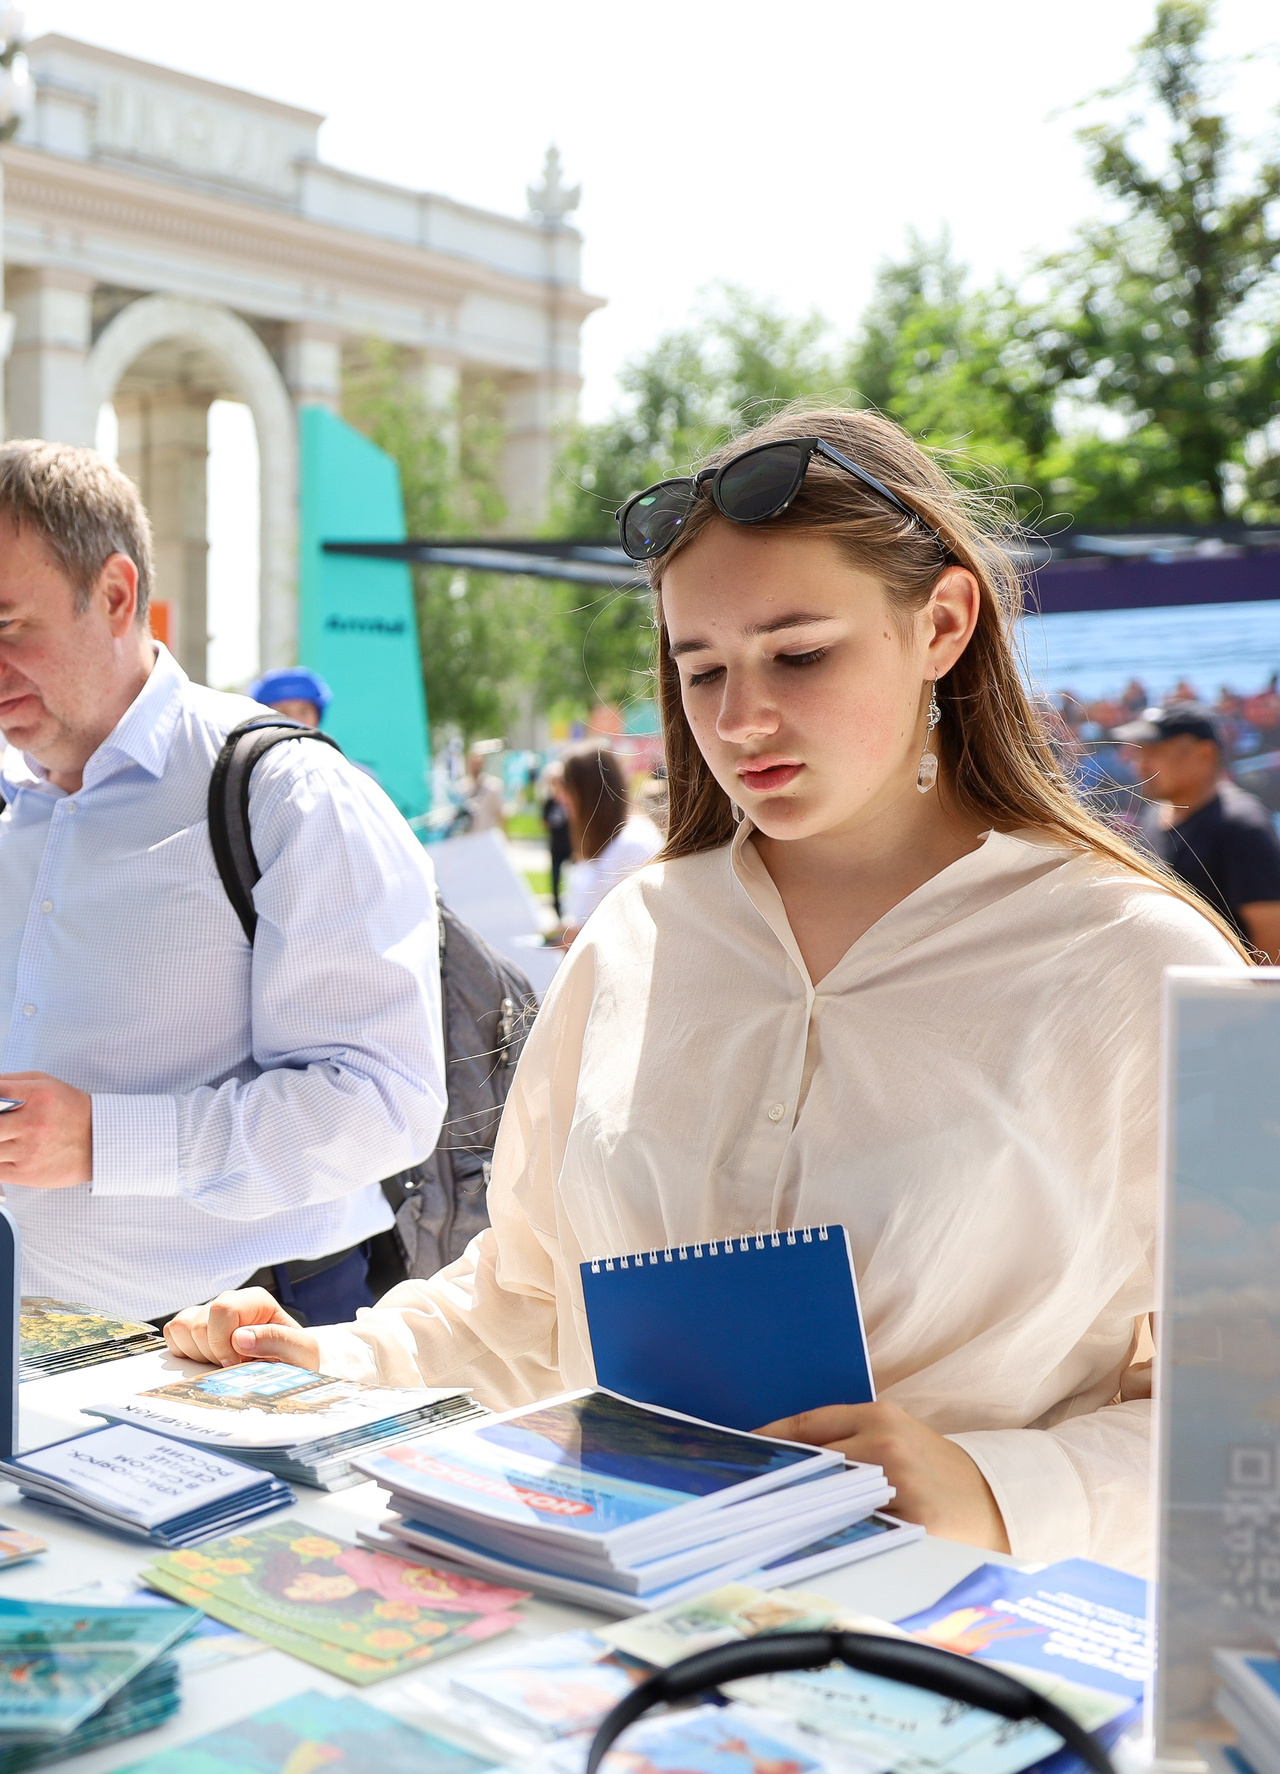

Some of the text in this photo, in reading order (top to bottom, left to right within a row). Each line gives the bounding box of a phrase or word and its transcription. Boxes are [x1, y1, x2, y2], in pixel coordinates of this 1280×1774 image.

[114, 1454, 184, 1484] САМОМ
[144, 1453, 216, 1483] СЕРДЦЕ
[155, 1445, 233, 1477] РОССИИ
